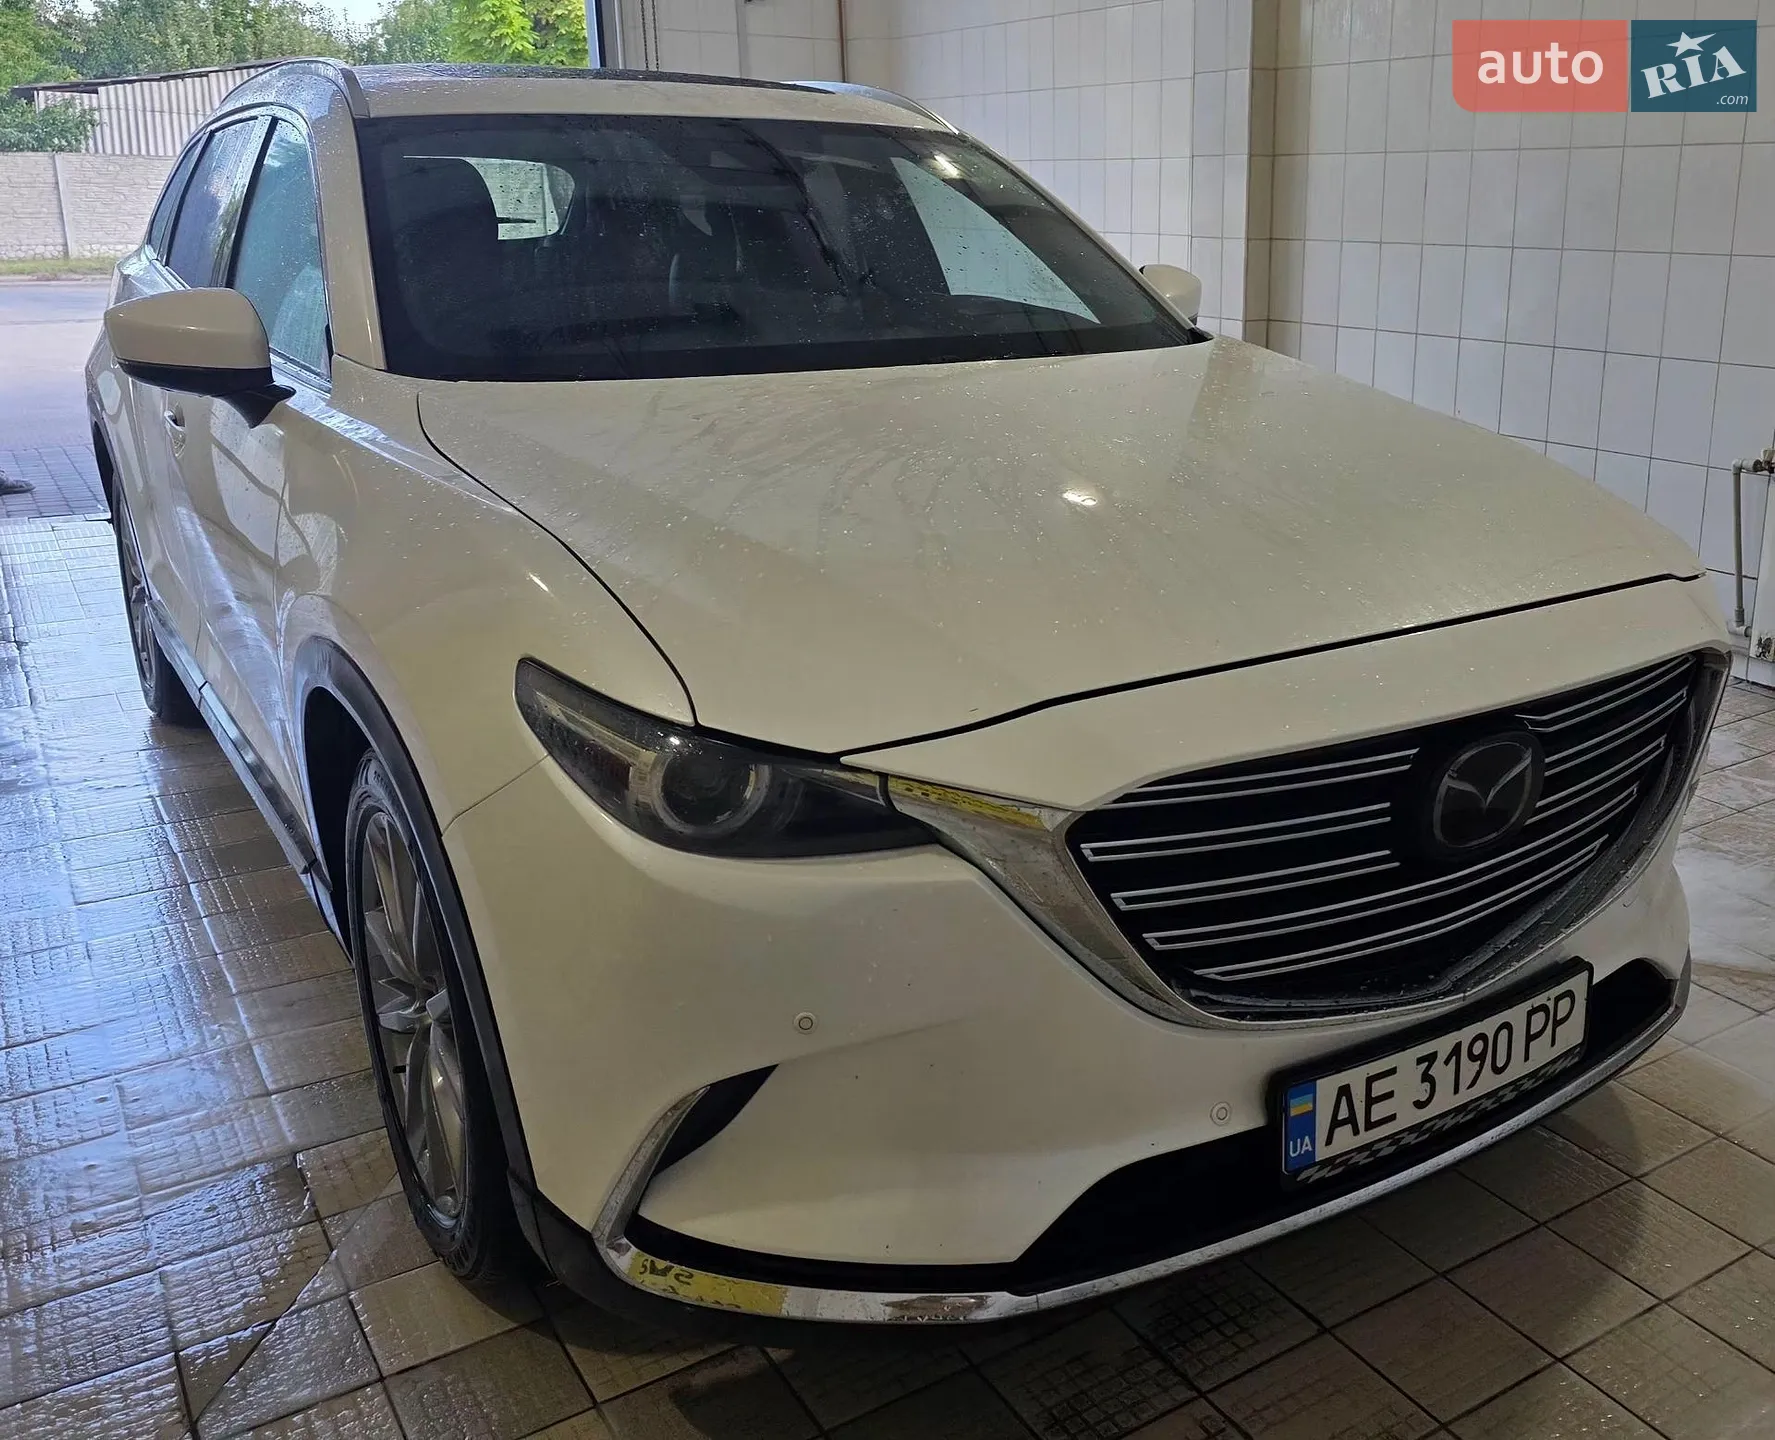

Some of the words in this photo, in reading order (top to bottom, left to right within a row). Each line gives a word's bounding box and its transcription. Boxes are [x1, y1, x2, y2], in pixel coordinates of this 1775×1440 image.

[1325, 1066, 1397, 1146] AE
[1412, 1021, 1513, 1109] 3190
[1523, 989, 1576, 1062] PP
[1289, 1143, 1313, 1157] UA
